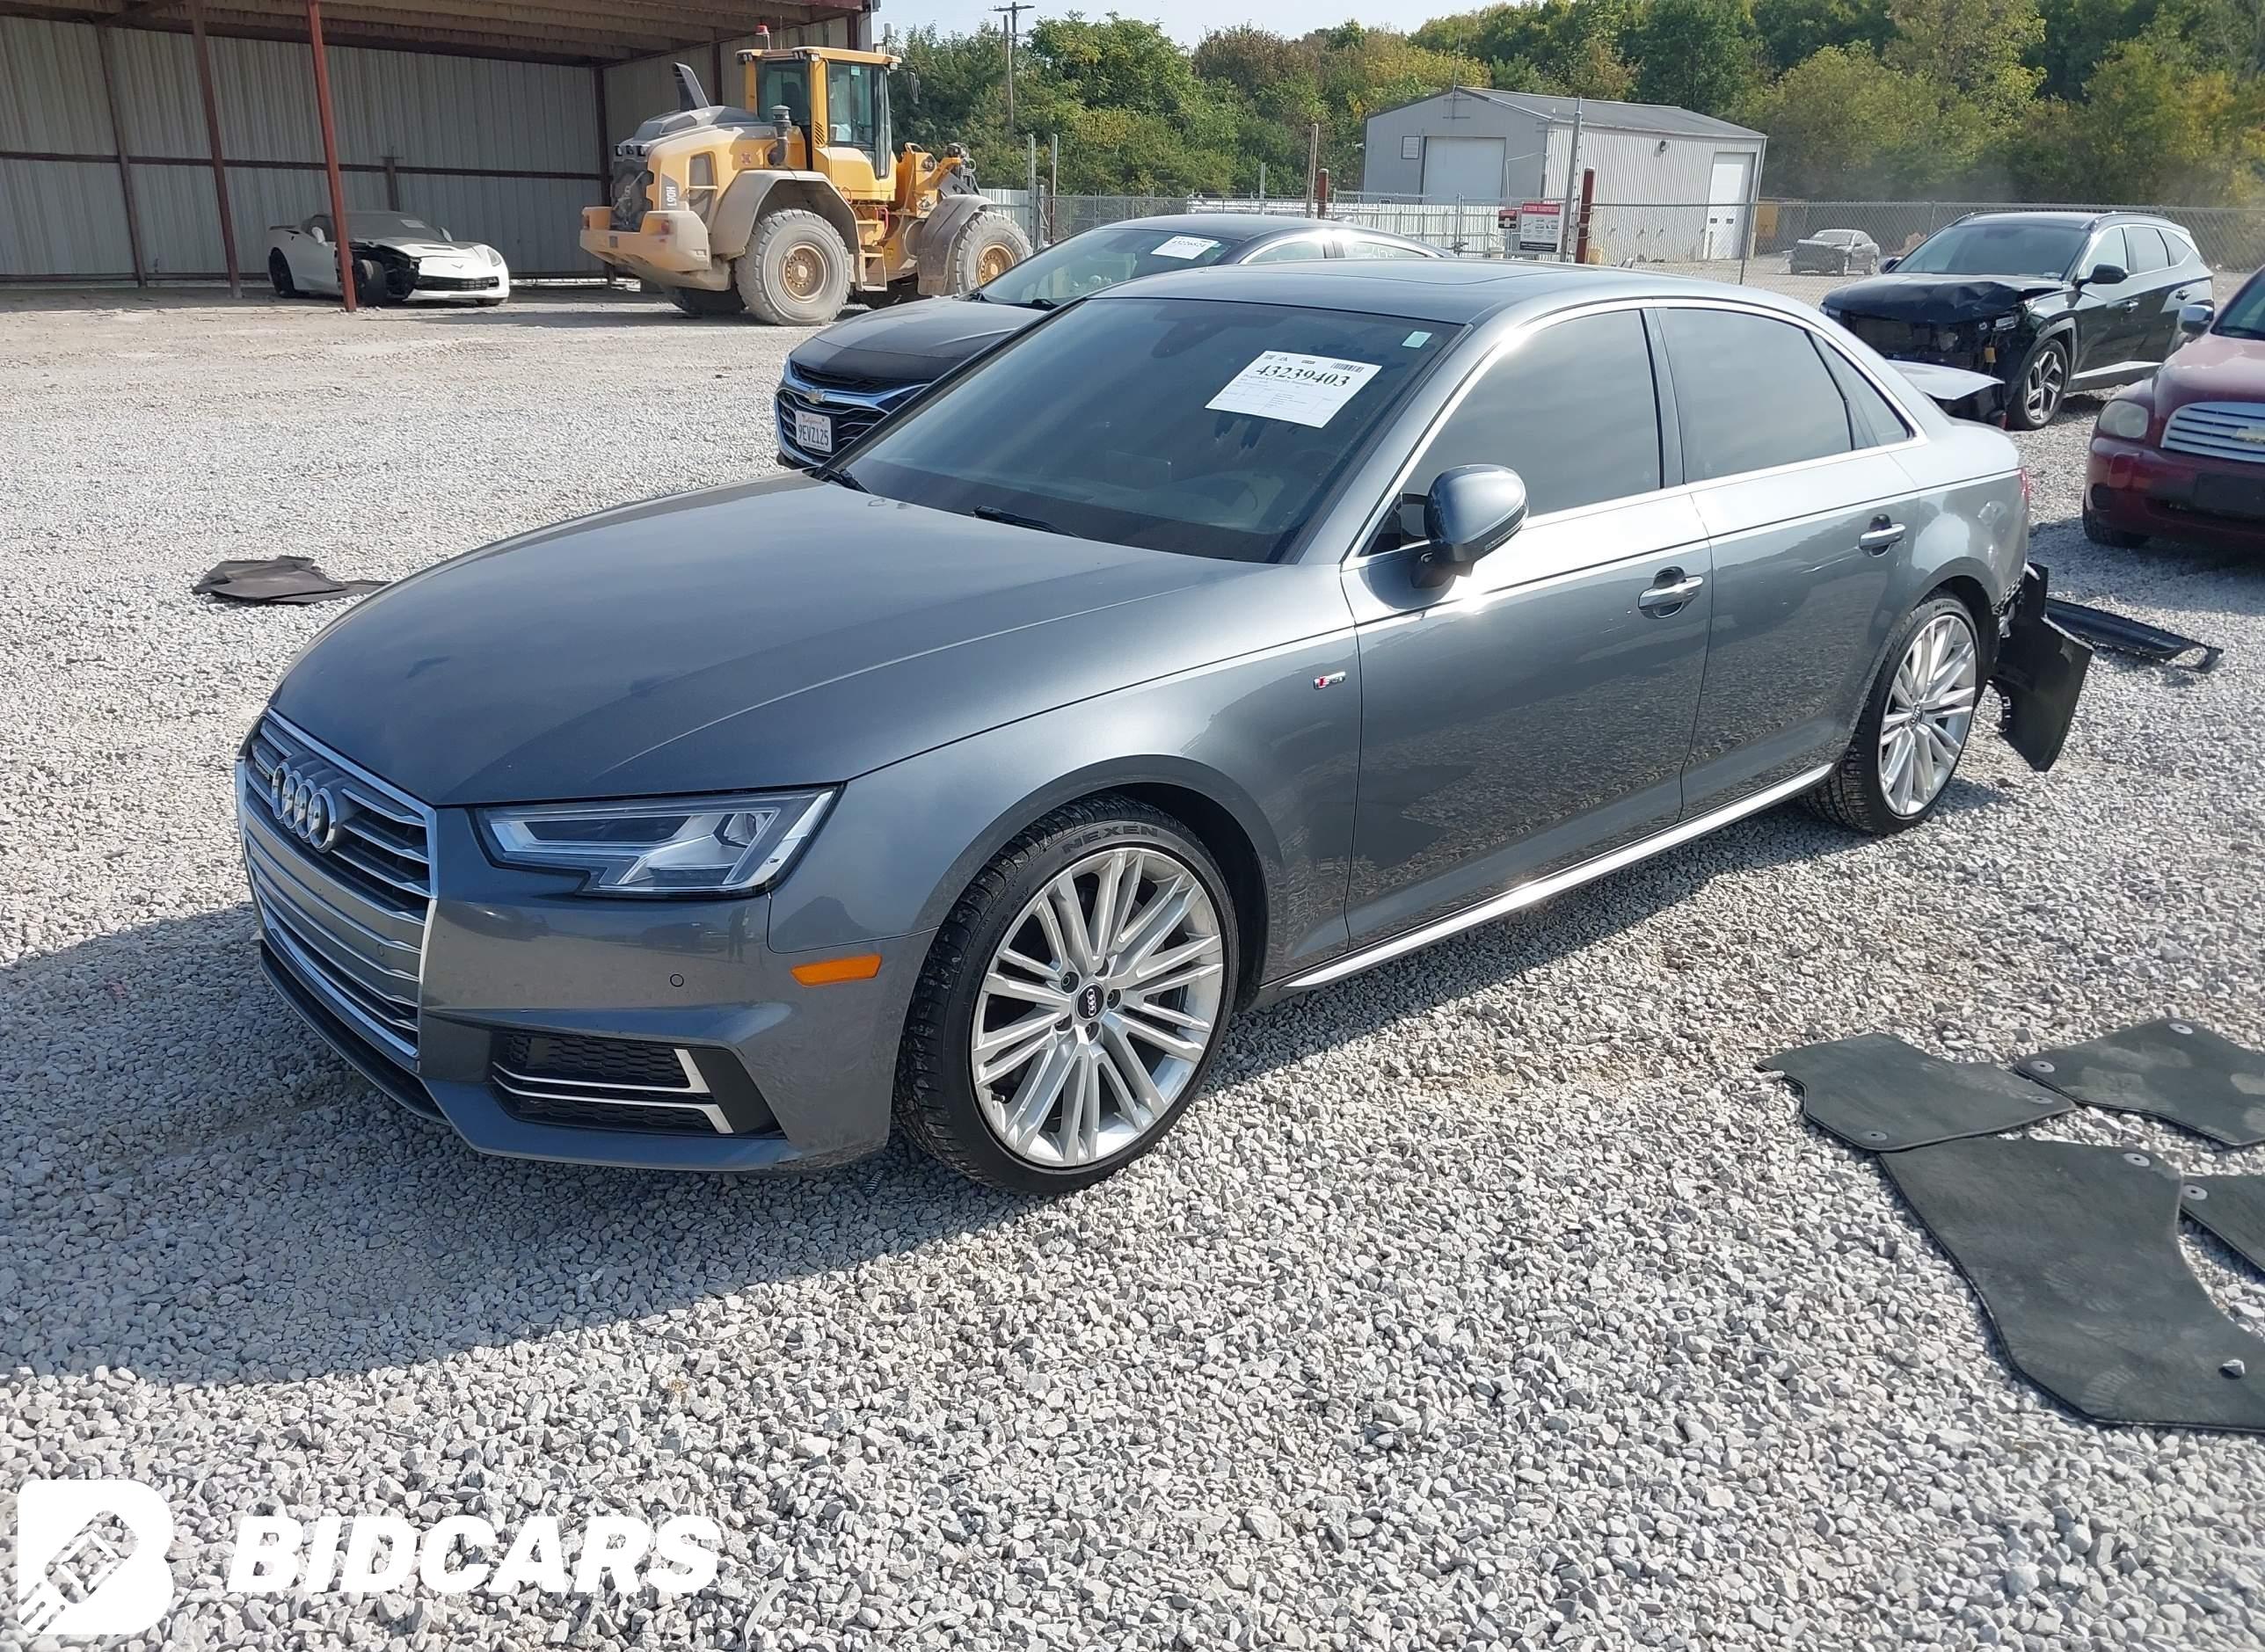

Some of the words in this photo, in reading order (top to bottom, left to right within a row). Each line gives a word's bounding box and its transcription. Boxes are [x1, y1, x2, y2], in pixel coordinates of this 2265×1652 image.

[666, 186, 676, 207] L90H
[1256, 365, 1350, 387] 43239403
[798, 424, 829, 447] 9EVZ125
[1061, 826, 1158, 855] NEXEN
